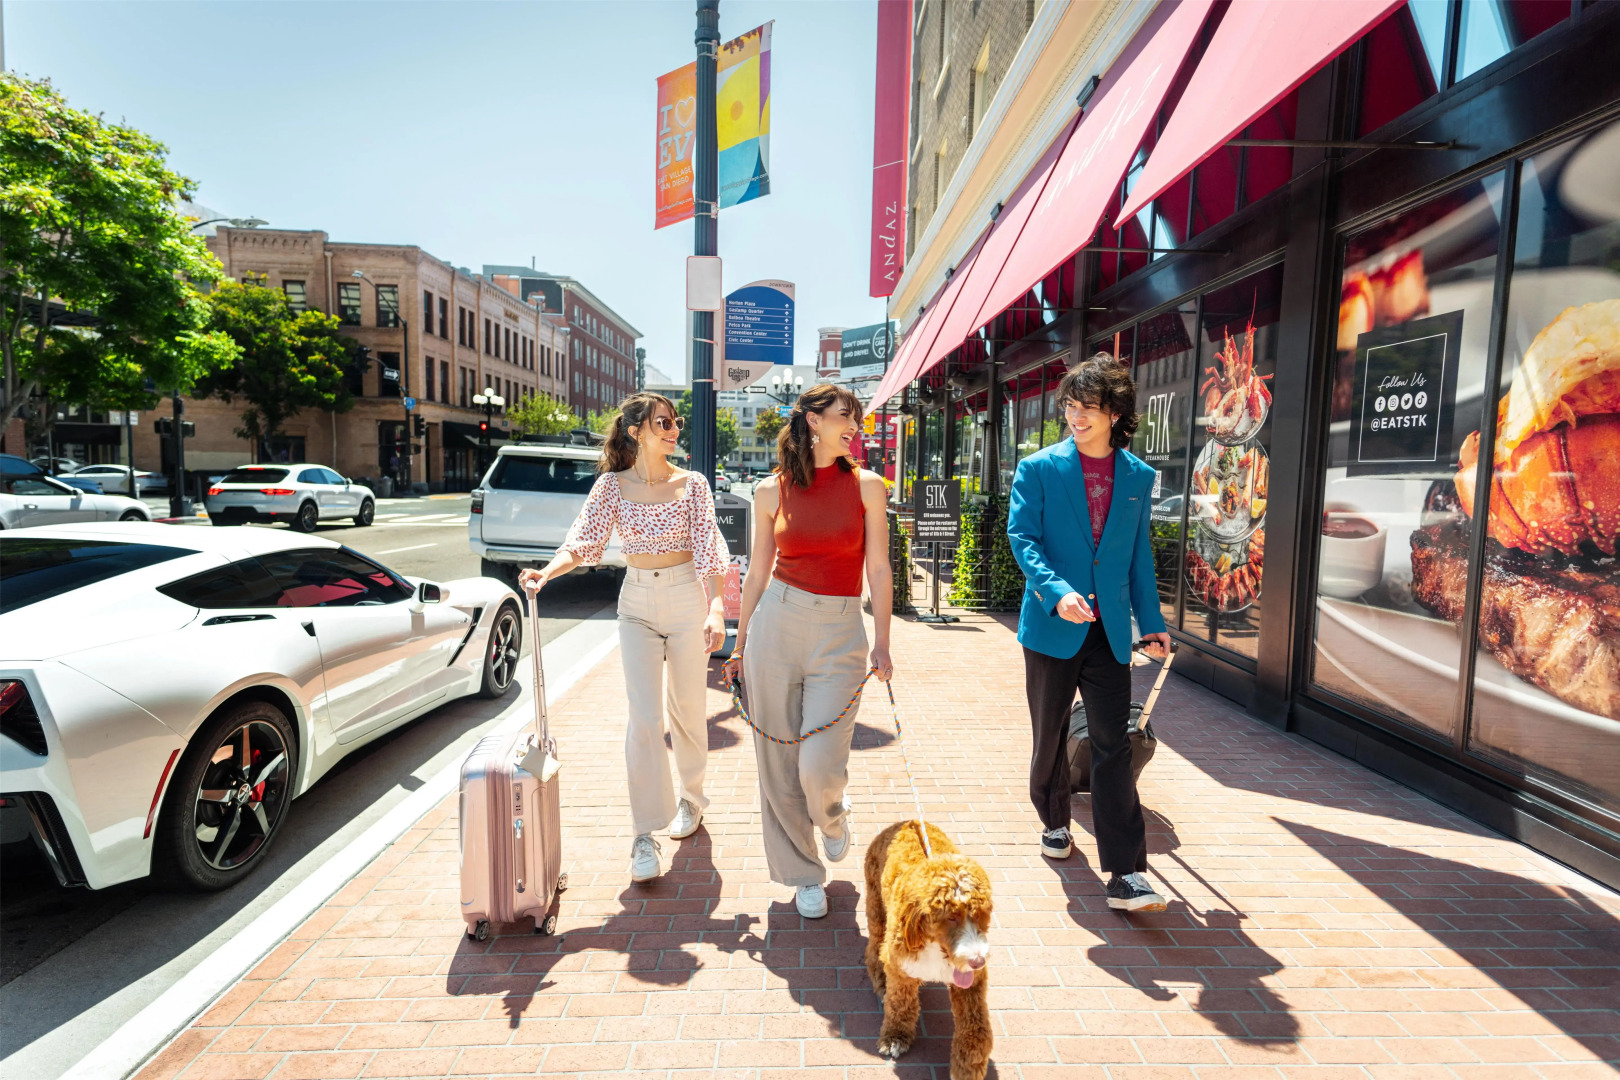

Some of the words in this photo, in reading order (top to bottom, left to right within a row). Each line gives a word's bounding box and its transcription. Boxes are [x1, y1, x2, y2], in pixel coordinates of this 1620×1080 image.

[659, 104, 673, 136] I
[658, 131, 693, 170] EV
[658, 174, 668, 186] EAST
[670, 166, 691, 179] VILLAGE
[660, 182, 670, 192] SAN
[672, 176, 690, 188] DIEGO
[1410, 372, 1427, 386] Us
[1146, 392, 1173, 453] STK
[1371, 414, 1427, 432] @EATSTK
[926, 484, 947, 506] STK
